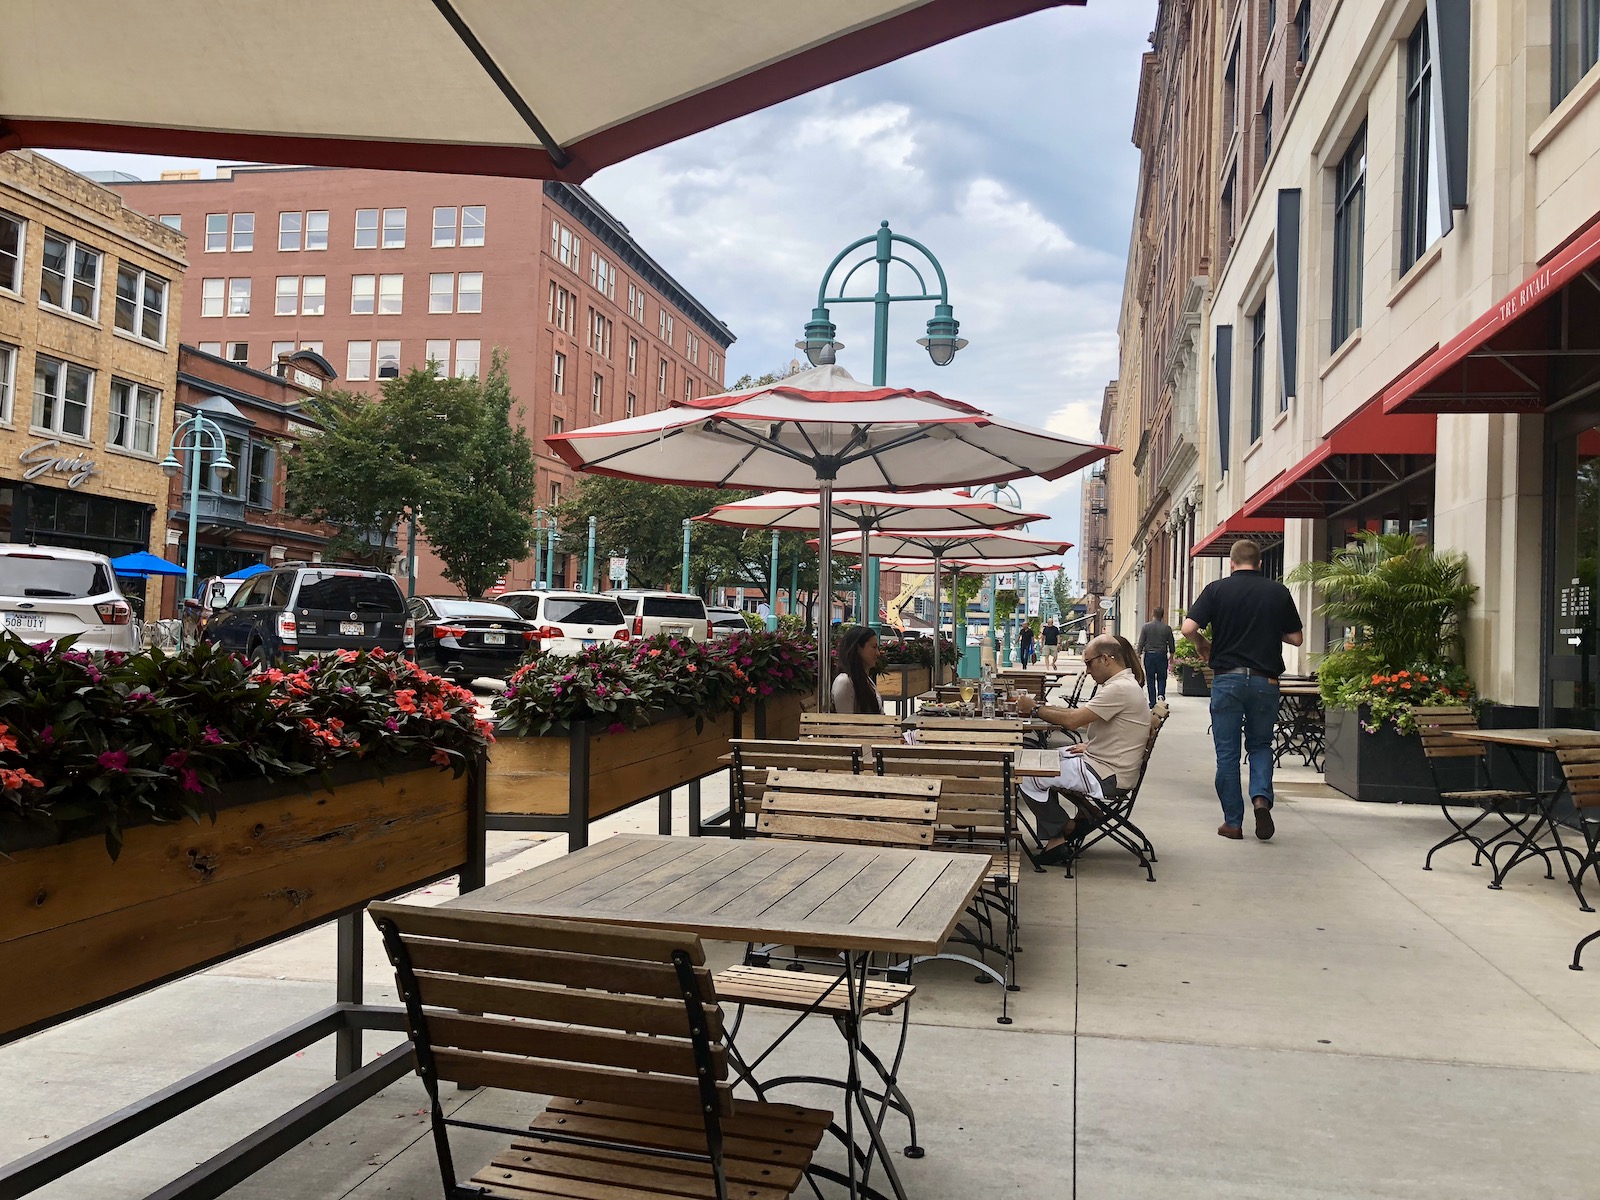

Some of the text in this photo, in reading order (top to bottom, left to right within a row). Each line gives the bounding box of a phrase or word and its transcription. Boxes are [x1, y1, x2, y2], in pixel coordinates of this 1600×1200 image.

[1500, 269, 1550, 320] TRE RIVALI
[5, 618, 44, 628] 508 UIY
